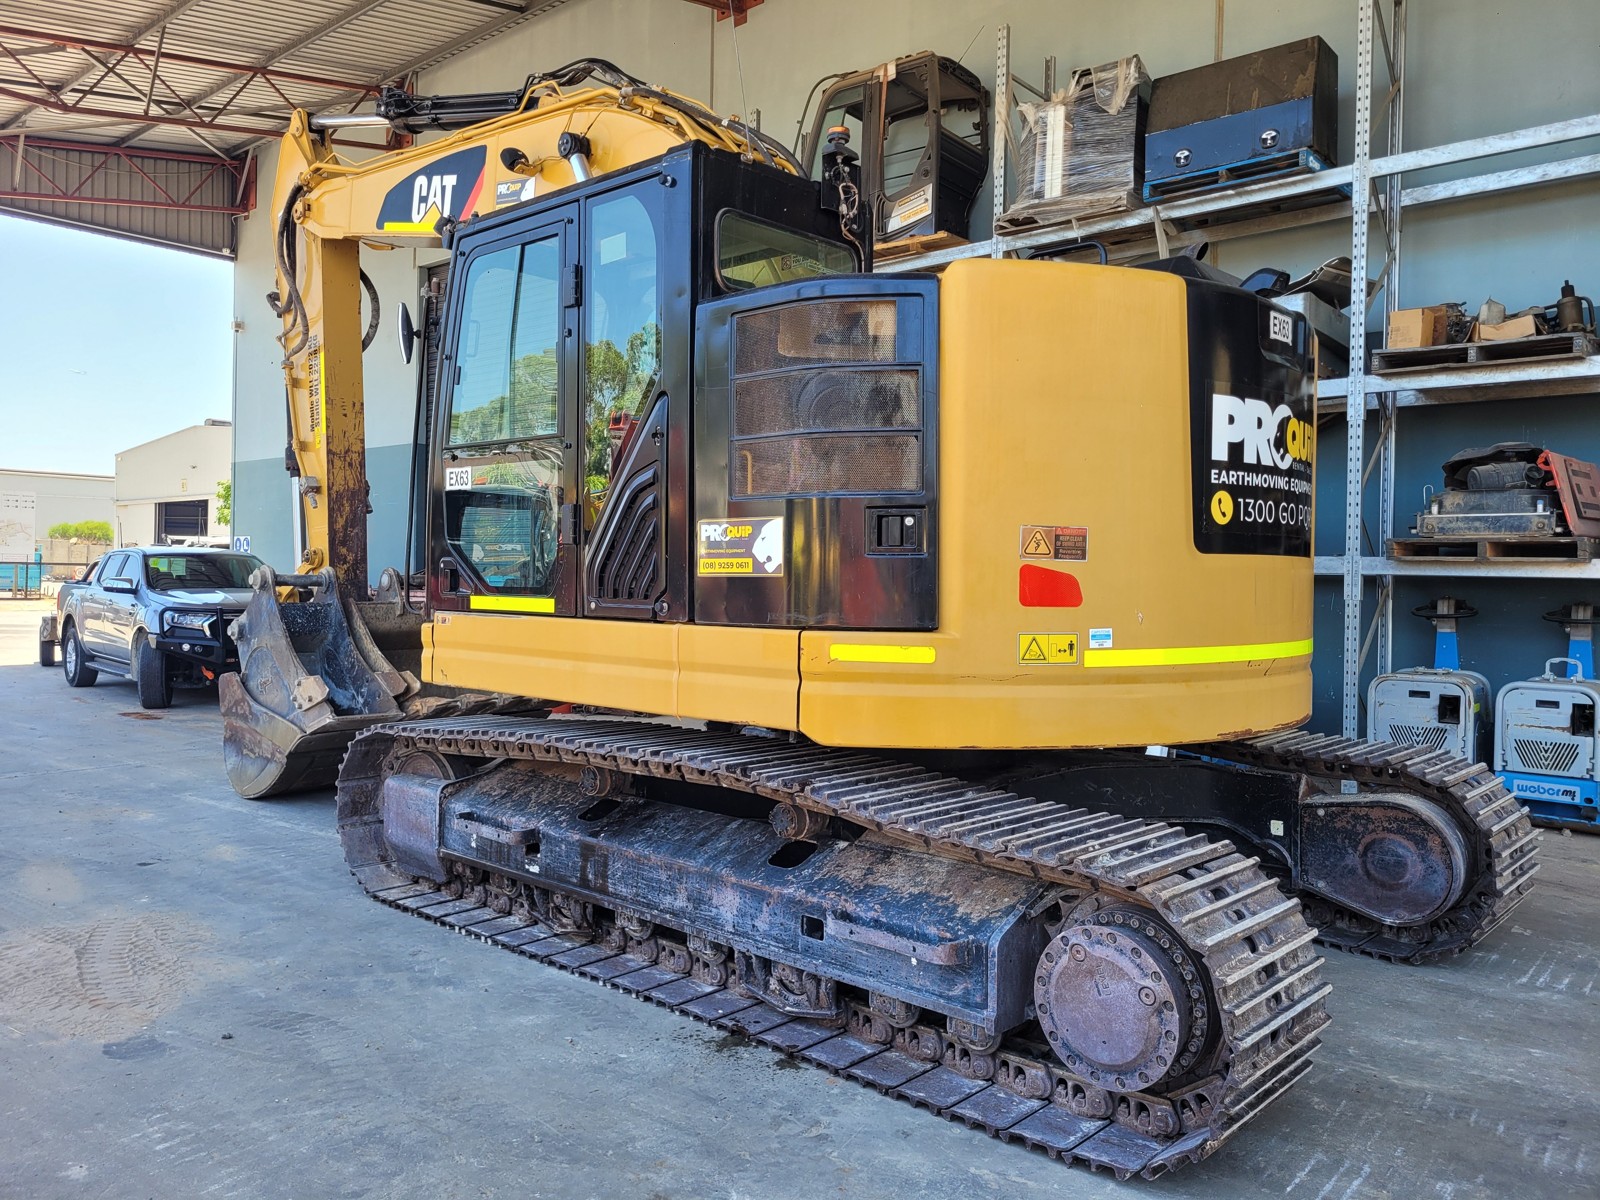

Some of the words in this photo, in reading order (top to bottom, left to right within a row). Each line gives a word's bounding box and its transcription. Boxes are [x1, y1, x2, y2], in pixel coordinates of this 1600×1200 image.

[411, 174, 458, 224] CAT
[1272, 315, 1290, 340] EX63
[449, 470, 469, 487] EX63
[1211, 469, 1289, 490] EARTHMOVING
[1238, 498, 1275, 523] 1300
[1279, 502, 1297, 525] GO
[703, 561, 716, 570] (08)
[718, 561, 734, 569] 9259
[736, 561, 750, 569] 0611
[1517, 783, 1561, 797] weber
